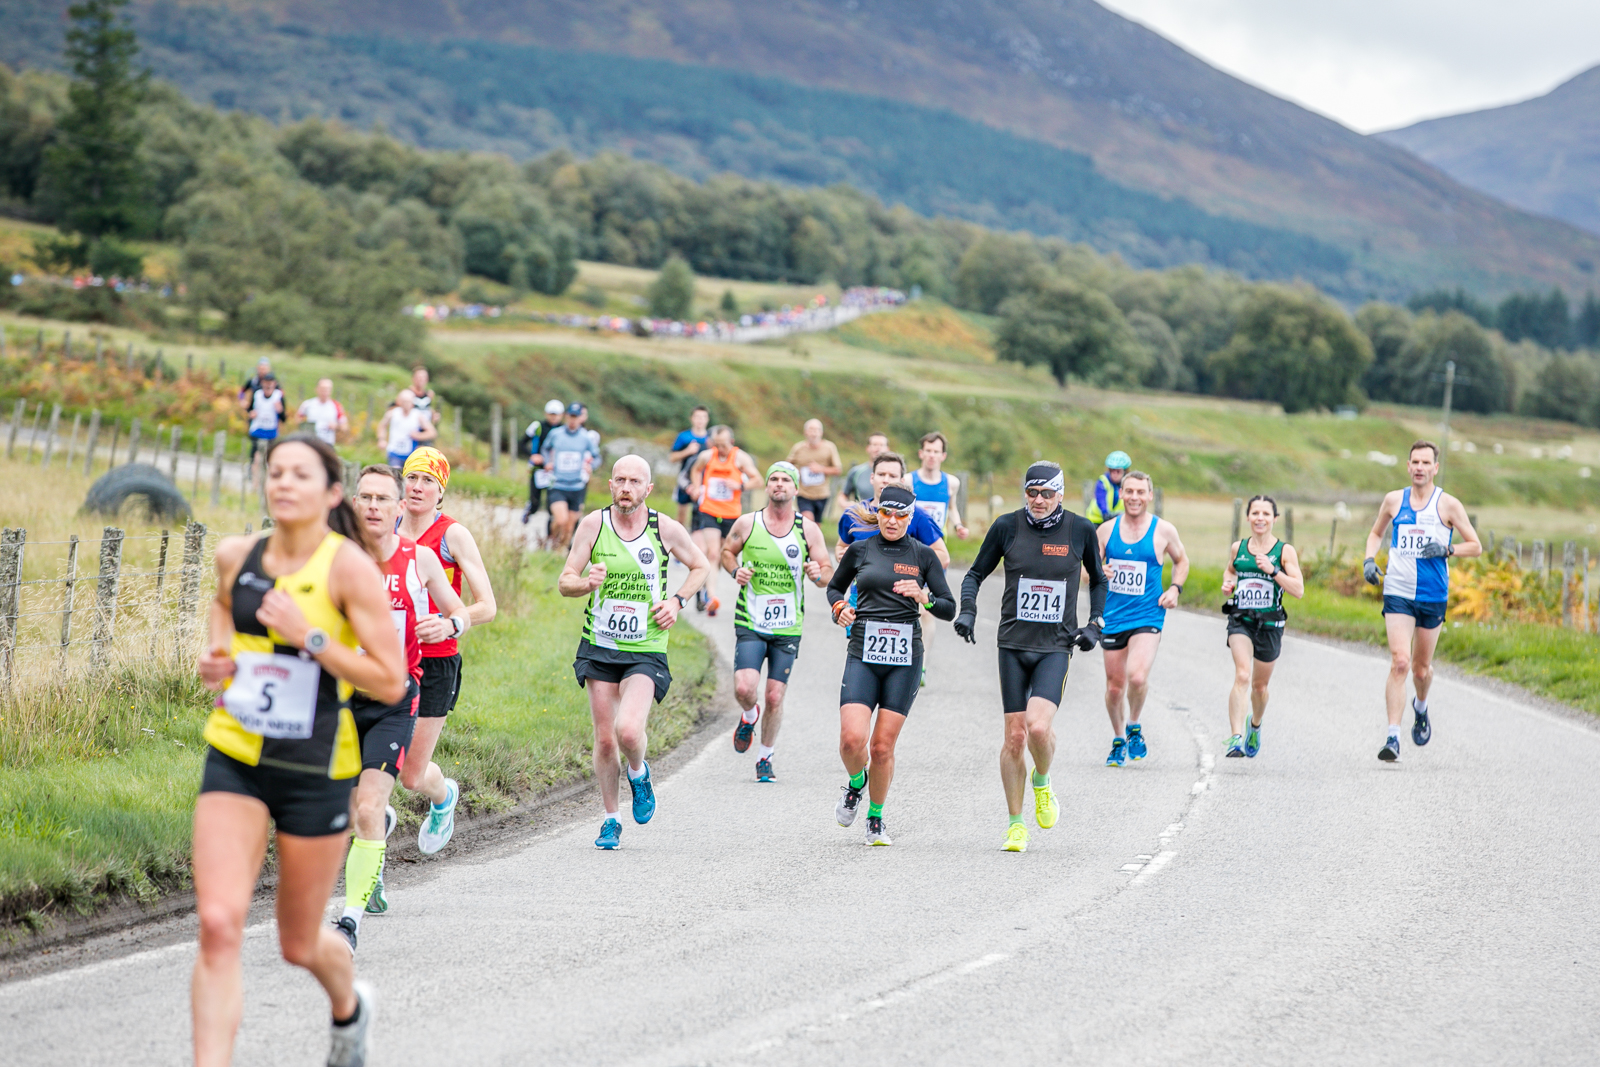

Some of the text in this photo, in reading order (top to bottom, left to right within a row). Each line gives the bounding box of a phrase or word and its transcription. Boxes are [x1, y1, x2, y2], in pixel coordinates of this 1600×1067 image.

[1400, 535, 1432, 549] 3187
[753, 561, 799, 571] Moneyglass
[606, 571, 655, 580] oneyglass
[770, 572, 798, 580] District
[1112, 569, 1143, 586] 2030
[382, 574, 400, 591] VE
[603, 582, 654, 591] and District
[759, 579, 792, 588] Runners
[607, 591, 646, 600] Runners
[1021, 592, 1061, 612] 2214
[764, 605, 787, 621] 691
[608, 613, 639, 633] 660
[601, 630, 622, 638] LOCH
[867, 635, 908, 655] 2213
[867, 654, 887, 662] LOCH
[257, 682, 276, 712] 5
